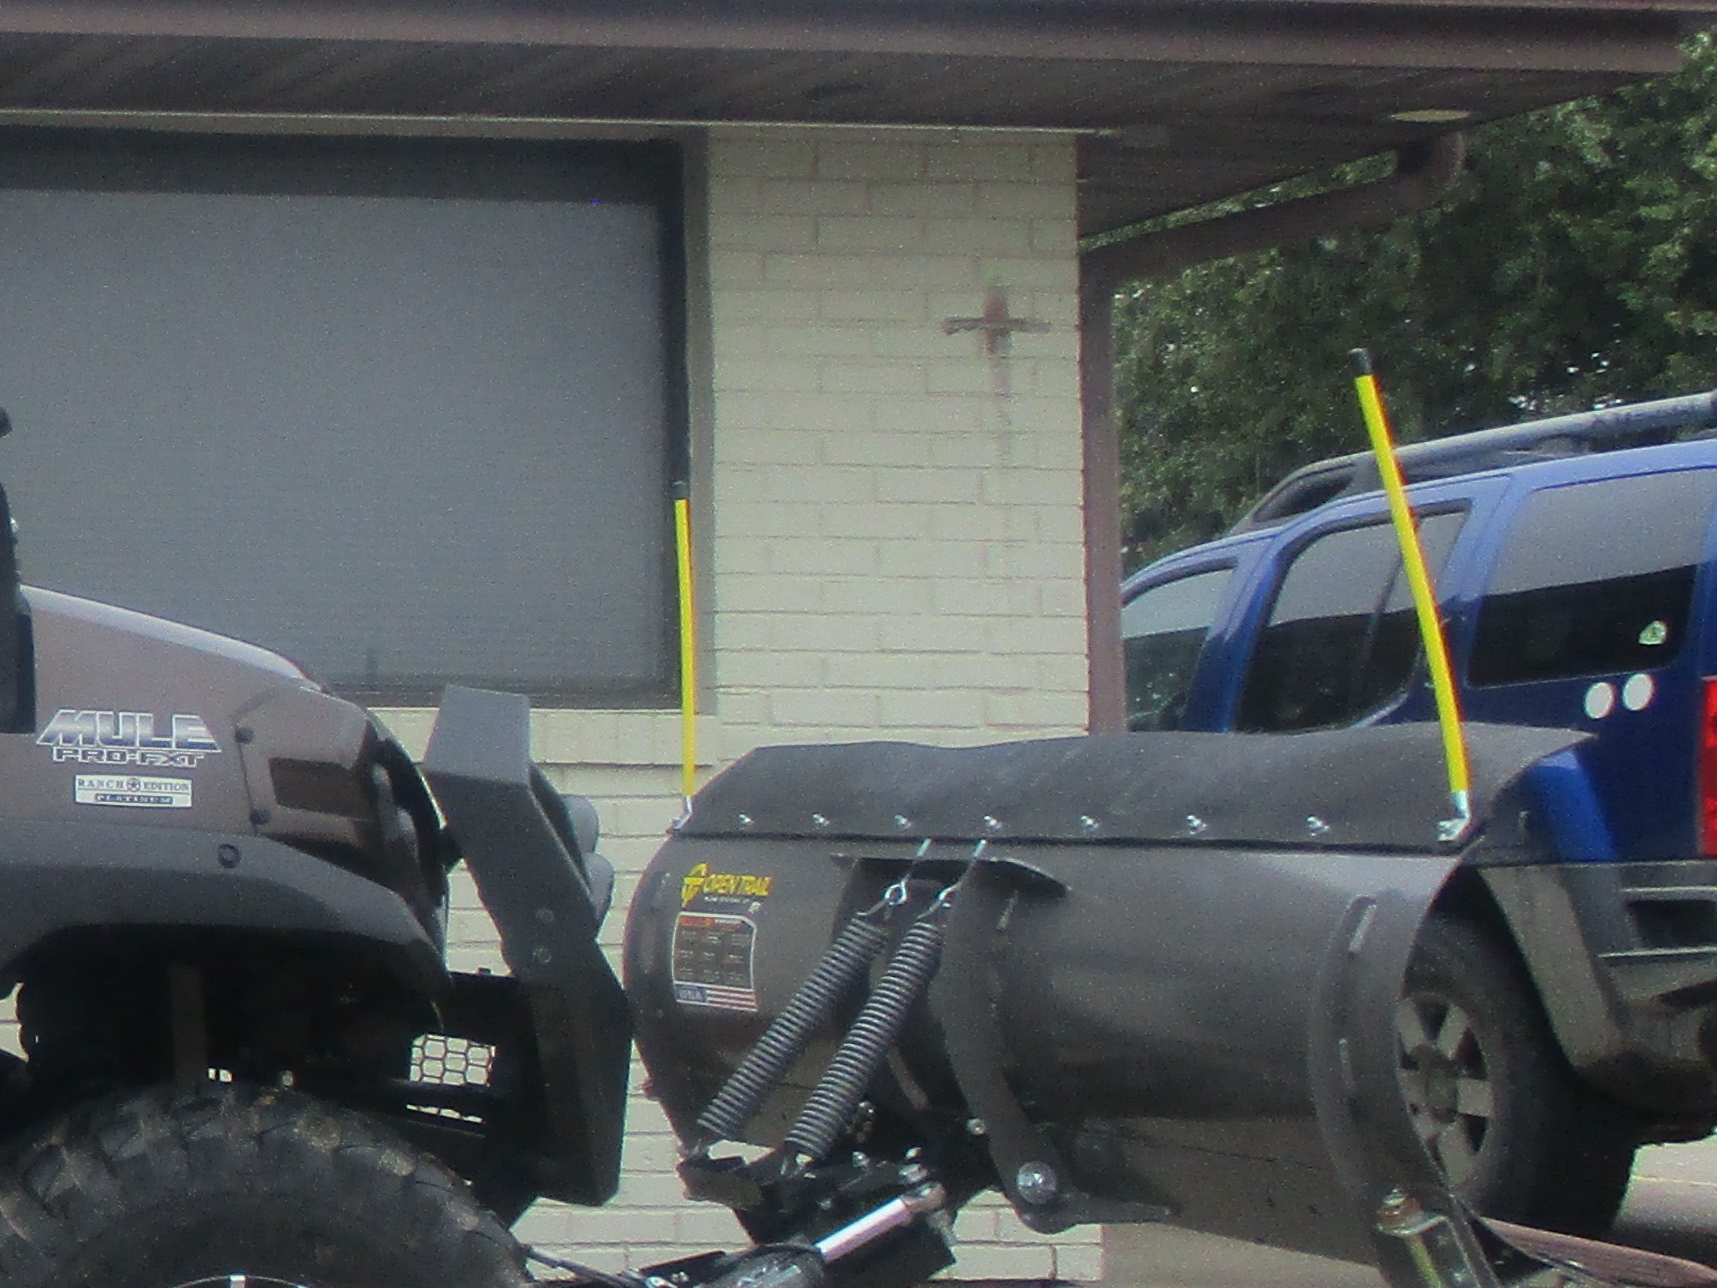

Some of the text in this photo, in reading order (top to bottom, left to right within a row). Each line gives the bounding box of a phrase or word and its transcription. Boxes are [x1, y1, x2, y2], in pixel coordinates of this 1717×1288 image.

[36, 709, 221, 753] MULE
[77, 778, 190, 792] RANCH EDITION
